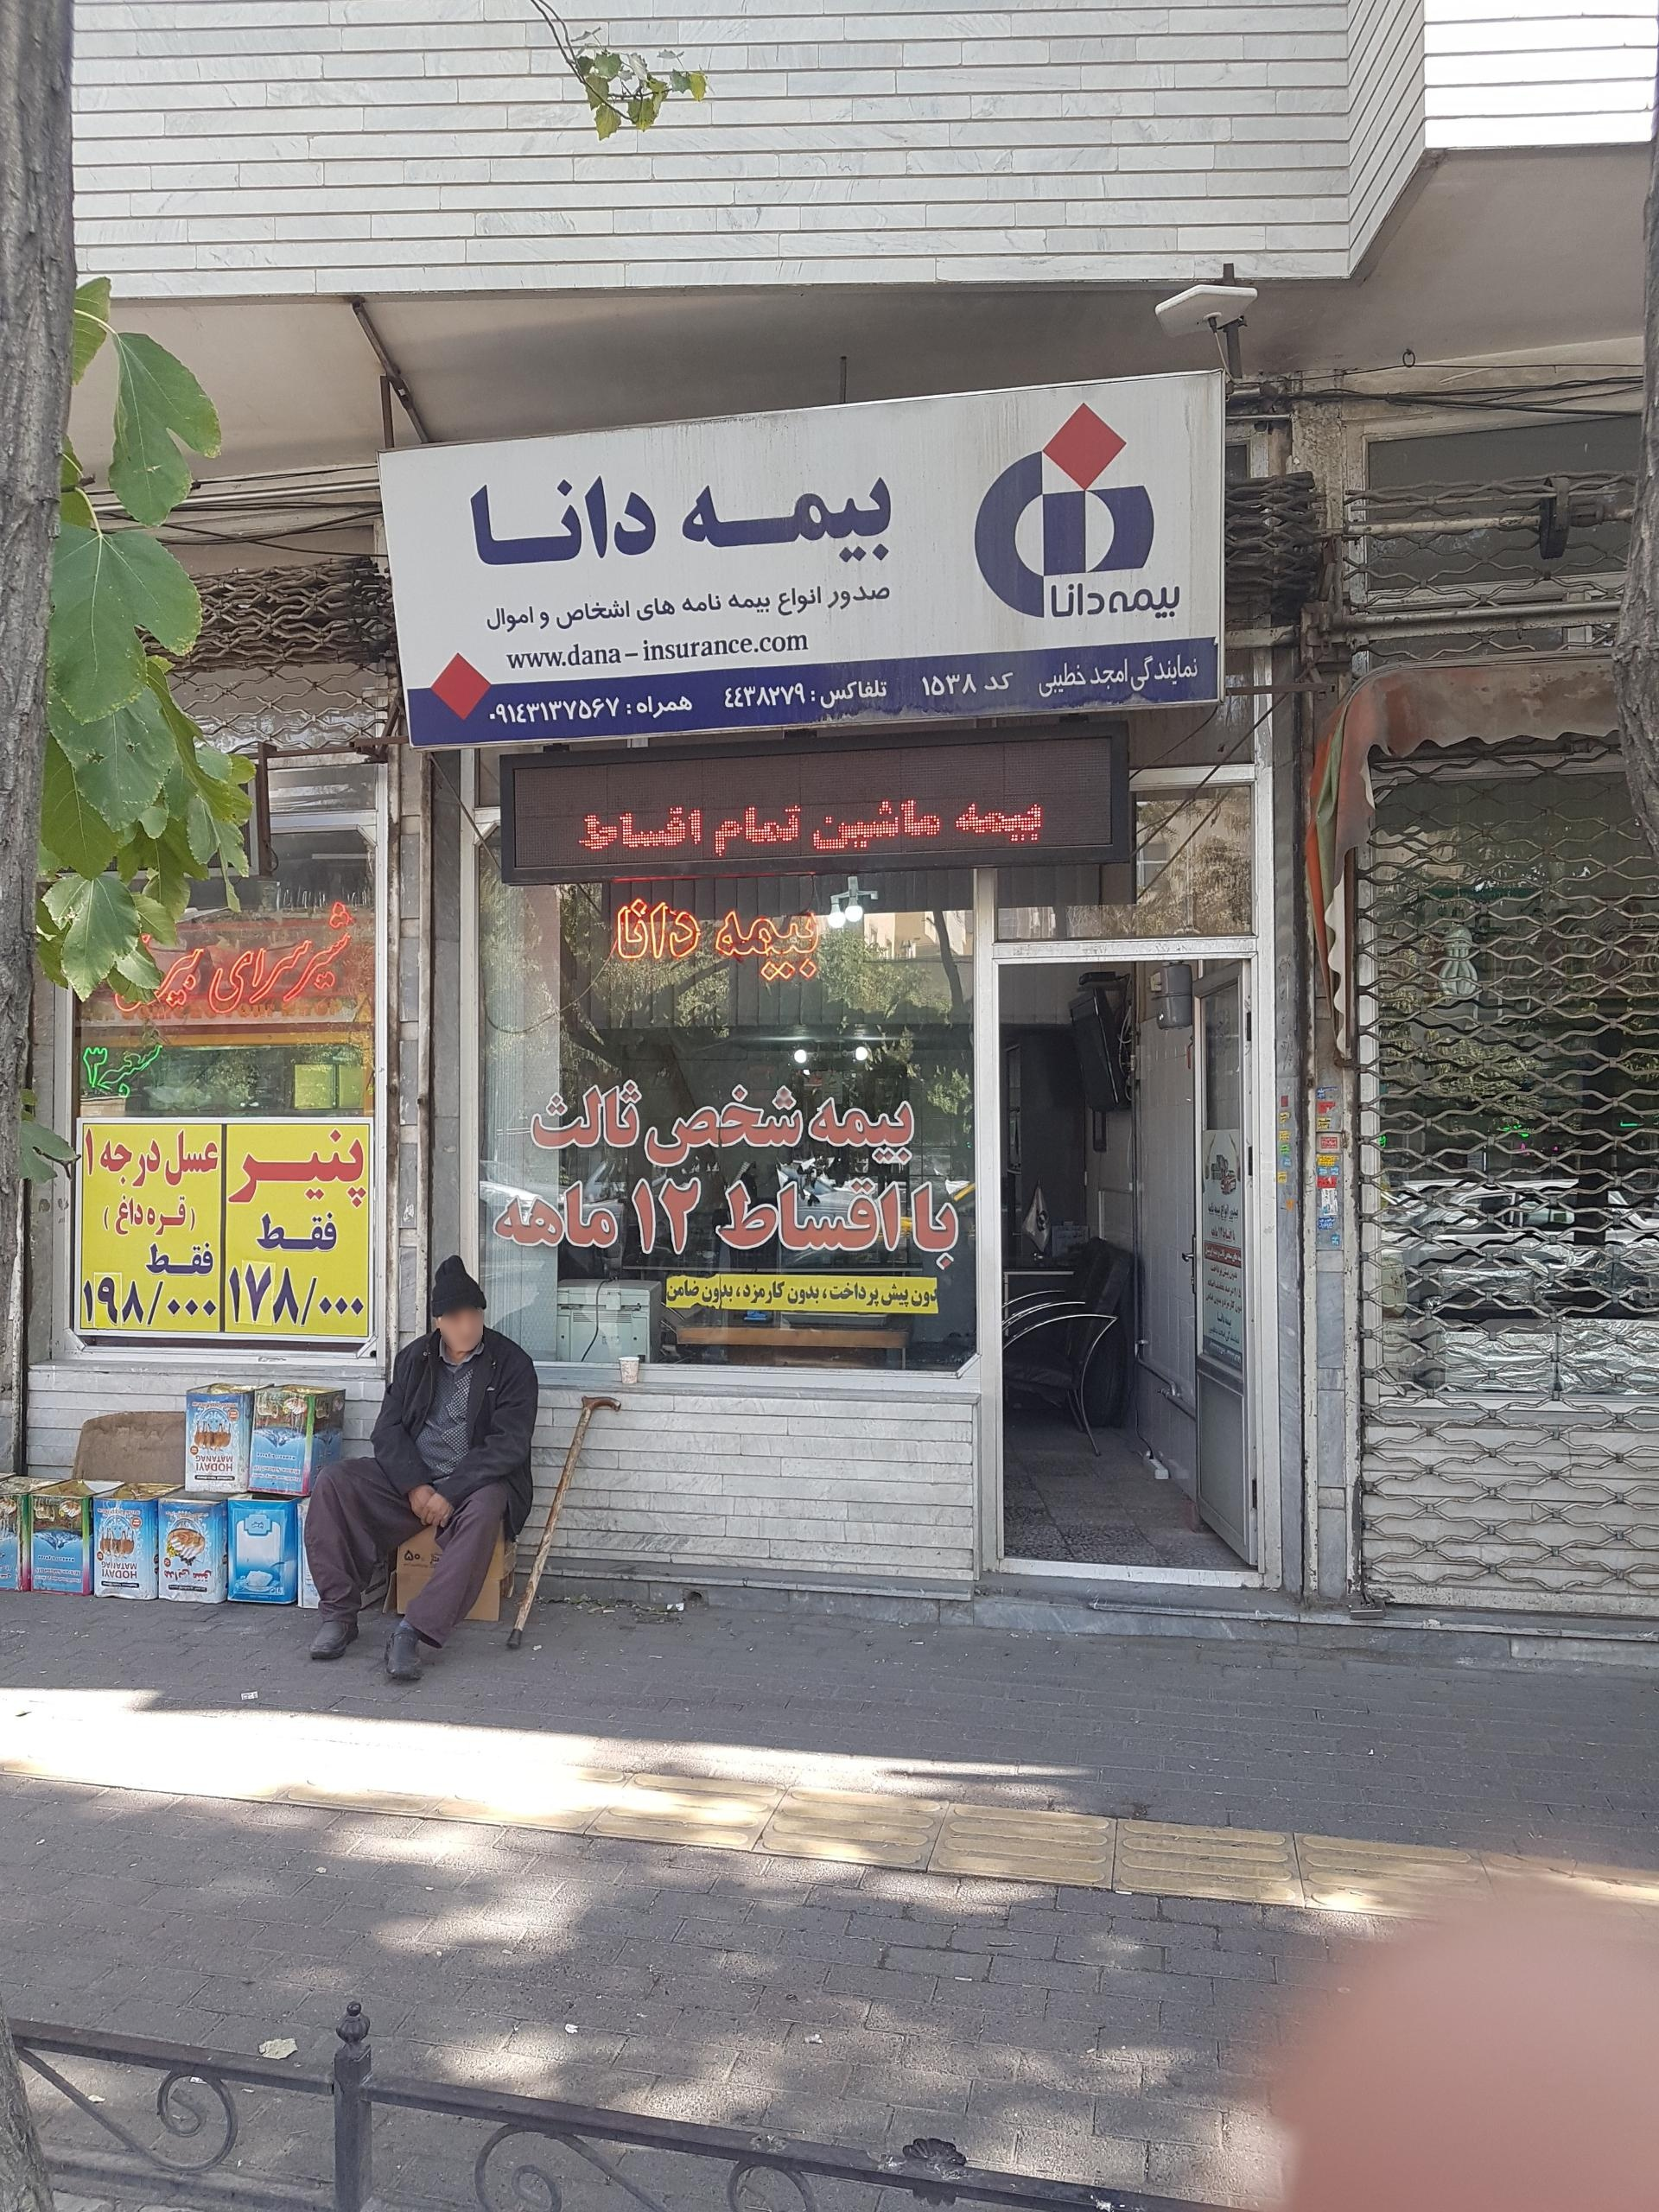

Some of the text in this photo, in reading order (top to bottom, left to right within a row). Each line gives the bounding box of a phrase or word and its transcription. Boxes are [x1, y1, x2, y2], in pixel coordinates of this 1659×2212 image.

[469, 475, 892, 566] بیمه دانا
[486, 585, 890, 632] صدور انواع بیمه نامه های اشخاص و اموال
[1051, 582, 1180, 619] بیمه دانا
[922, 672, 1014, 696] کد ۱۵۳۸
[1039, 654, 1198, 697] نمایندگی امجد خطیبی
[578, 799, 1042, 856] بیمه ماشین تمام اقساط
[615, 898, 819, 982] بیمه دانا
[530, 1078, 915, 1168] بیمه شخص ثالث
[99, 1141, 161, 1188] درجه
[164, 1130, 219, 1186] عسل
[228, 1128, 367, 1207] پنیر
[256, 1211, 338, 1252] فقط
[493, 1175, 959, 1270] با اقساط ۱۲ ماهه
[144, 1242, 214, 1275] فقط
[666, 1280, 700, 1302] ضامن
[702, 1284, 734, 1304] بدون
[786, 1286, 819, 1304] بدون
[881, 1283, 908, 1307] پیش
[195, 1463, 233, 1472] HODAYI
[101, 1569, 137, 1580] HODAYI
